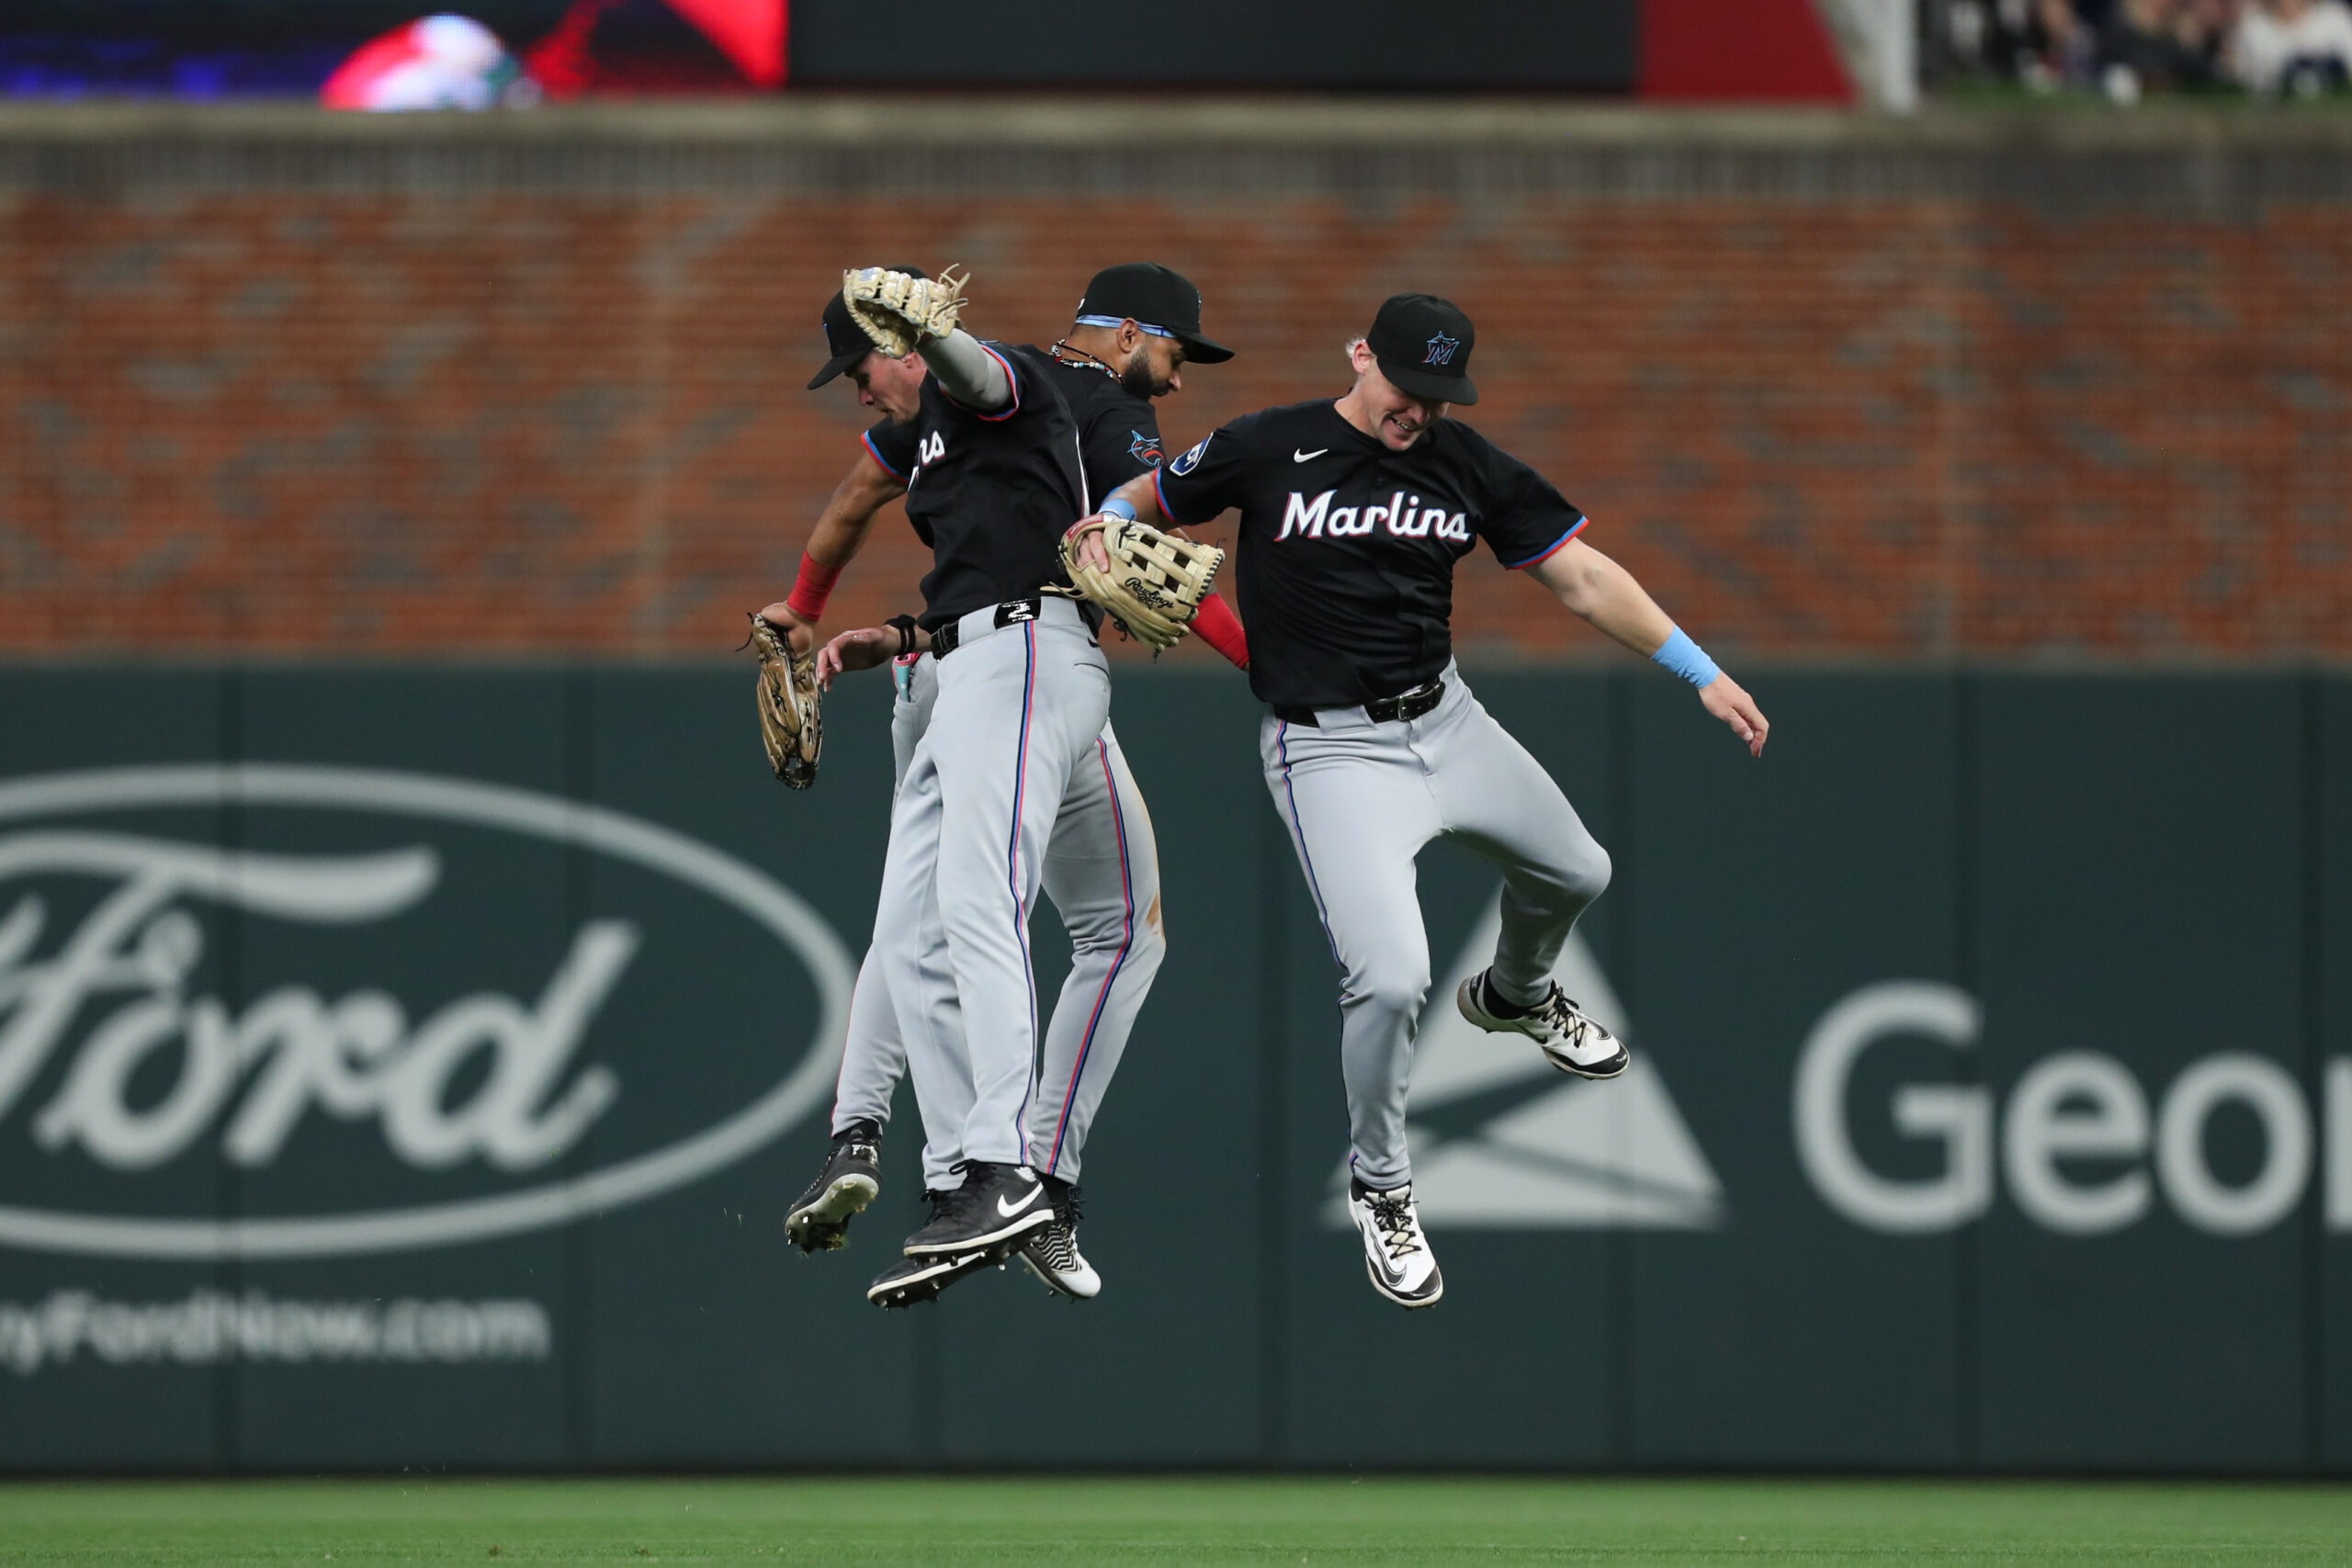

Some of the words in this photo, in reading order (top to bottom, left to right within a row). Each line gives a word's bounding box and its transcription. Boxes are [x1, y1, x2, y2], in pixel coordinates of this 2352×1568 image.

[1273, 489, 1471, 542] Marlins
[1125, 577, 1174, 608] Rawlings
[0, 831, 638, 1169] Ford
[0, 1290, 549, 1372] yFordNow.com
